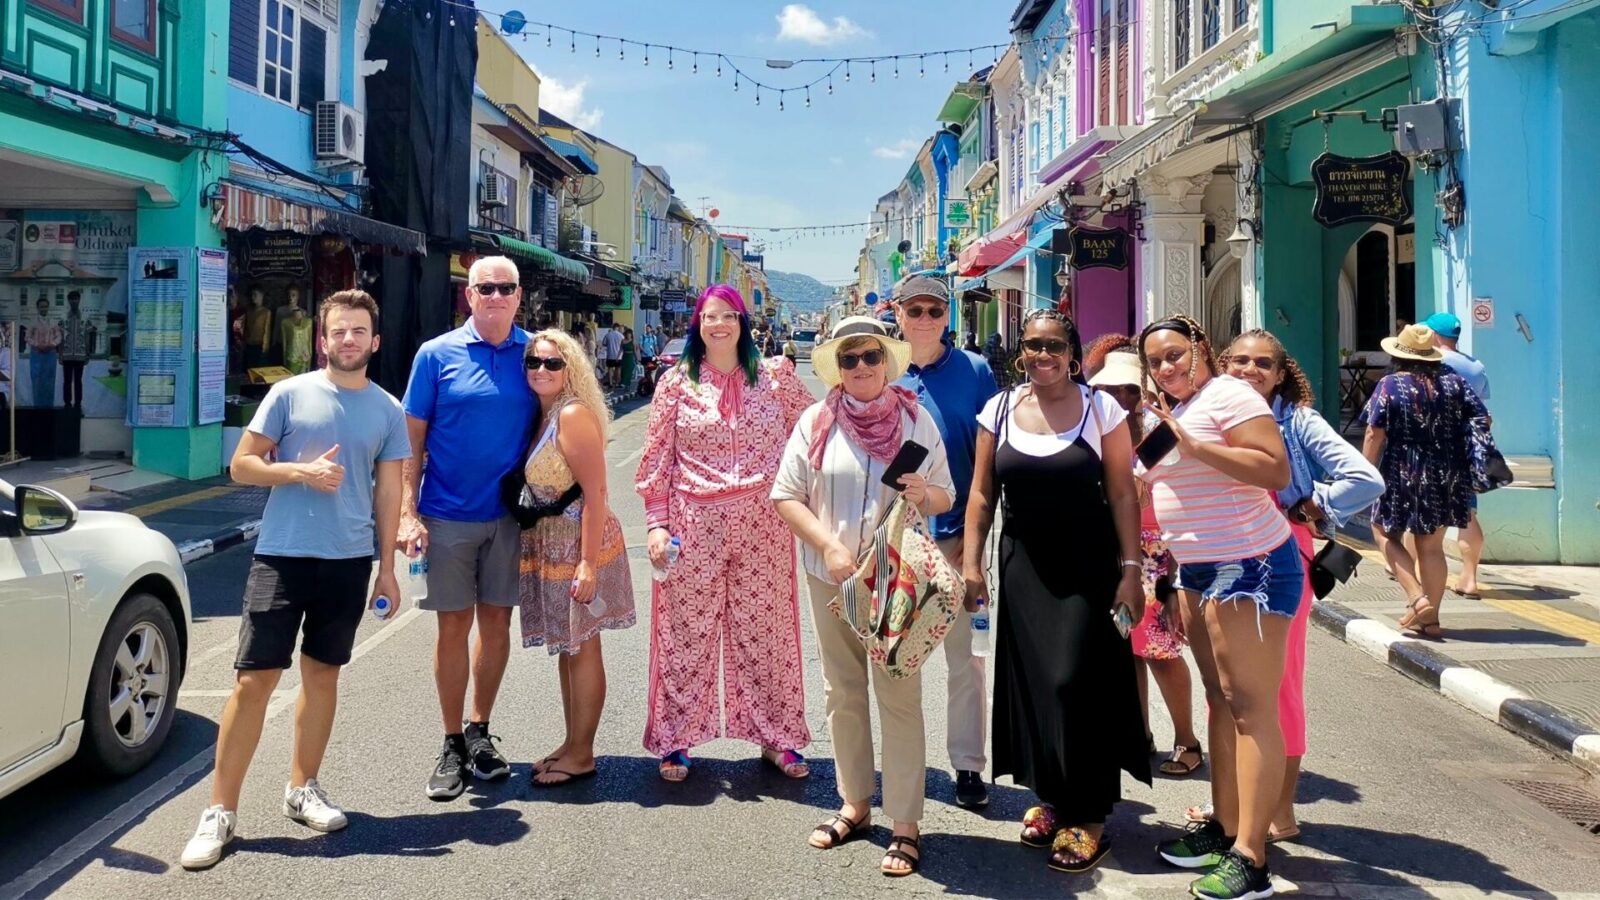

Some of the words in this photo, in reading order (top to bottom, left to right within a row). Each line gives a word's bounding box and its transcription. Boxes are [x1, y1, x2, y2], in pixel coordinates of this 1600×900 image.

[1328, 183, 1367, 192] THAVORN
[1369, 182, 1388, 191] BIKE
[1361, 194, 1385, 202] 215774
[77, 221, 132, 236] Phuket
[75, 237, 134, 250] Oldtown
[1083, 239, 1116, 249] BAAN
[1092, 249, 1108, 258] 125
